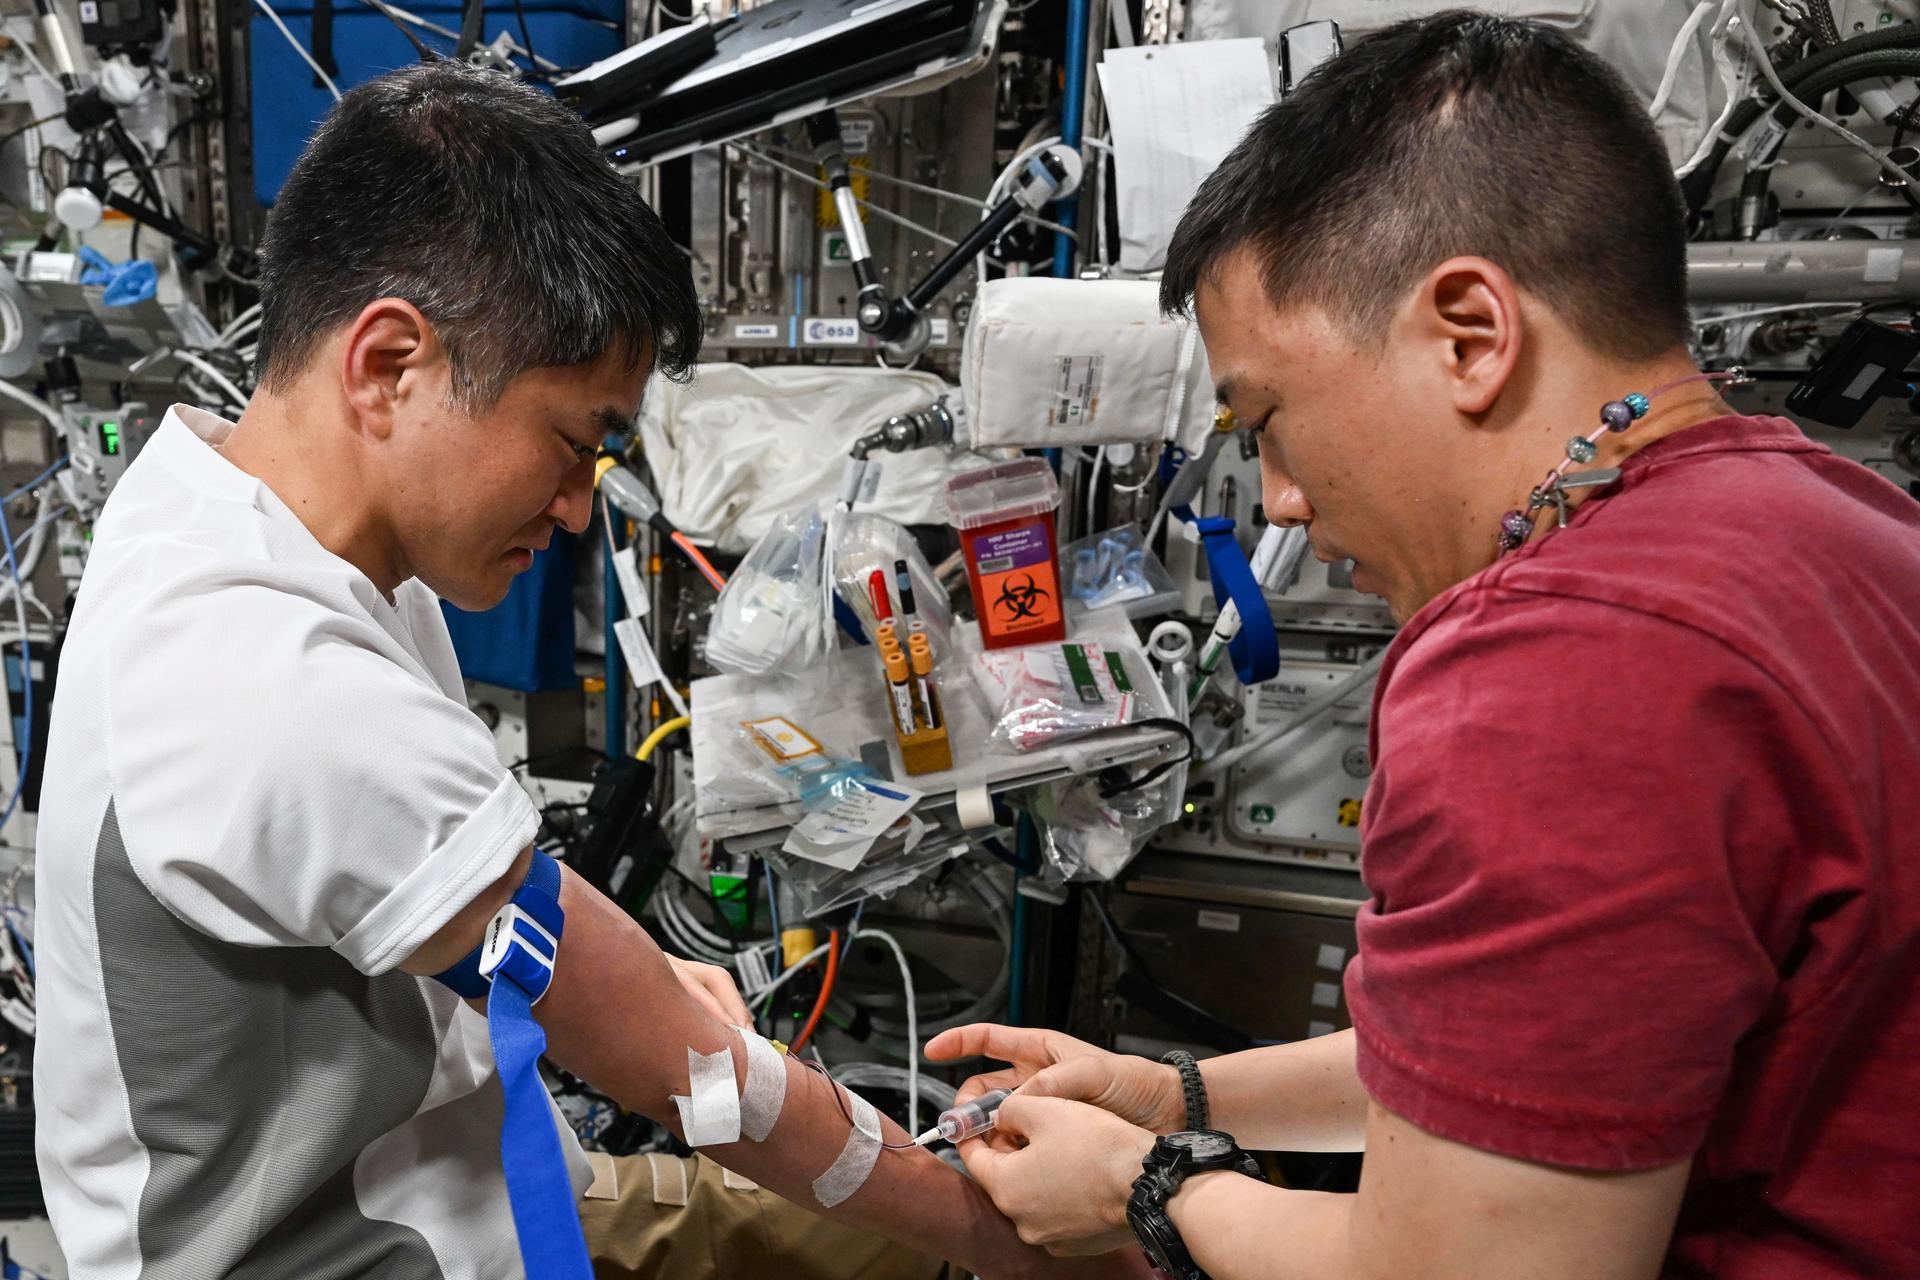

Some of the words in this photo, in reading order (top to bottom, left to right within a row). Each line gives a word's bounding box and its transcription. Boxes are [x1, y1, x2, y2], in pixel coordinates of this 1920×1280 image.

[827, 326, 854, 337] esa
[1005, 529, 1032, 541] Sharps
[993, 538, 1029, 551] Container
[1260, 683, 1306, 695] MERLIN
